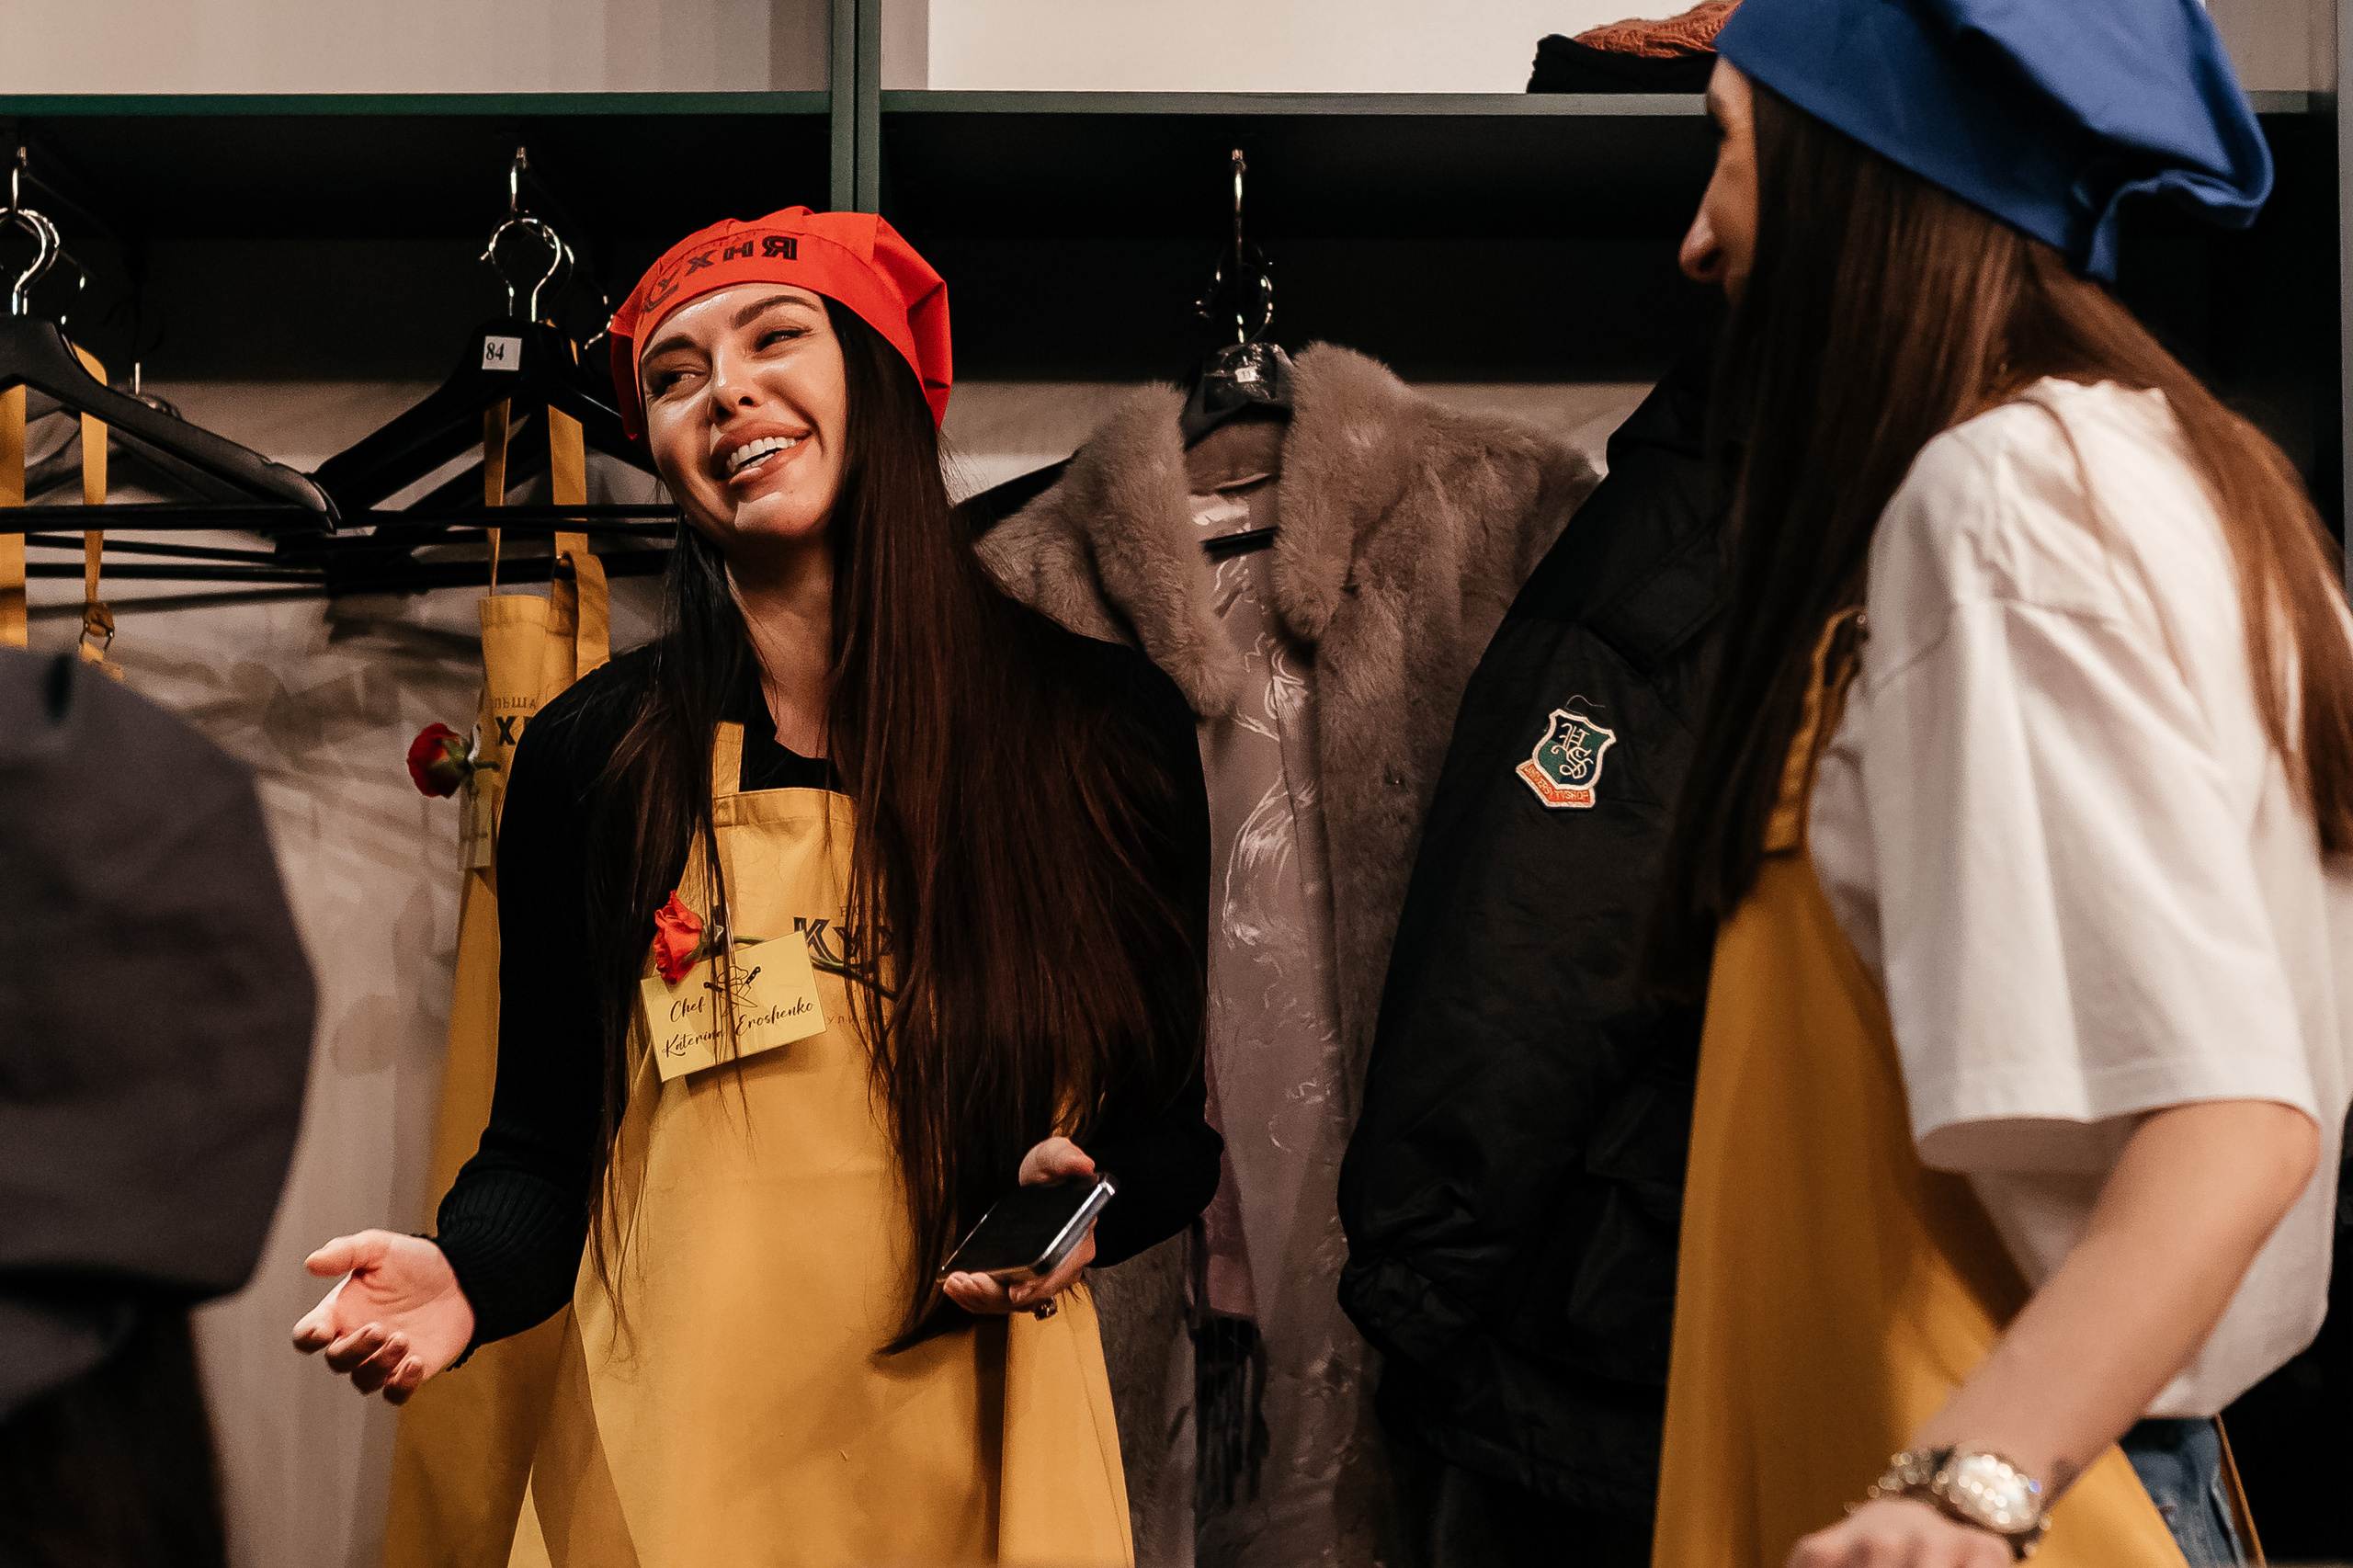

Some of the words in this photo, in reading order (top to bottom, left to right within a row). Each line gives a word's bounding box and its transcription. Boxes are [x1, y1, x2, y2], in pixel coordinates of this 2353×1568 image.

[485, 342, 505, 360] 84
[670, 996, 707, 1023] Chef
[661, 1029, 724, 1058] Katerina
[735, 997, 813, 1036] Eroshenko
